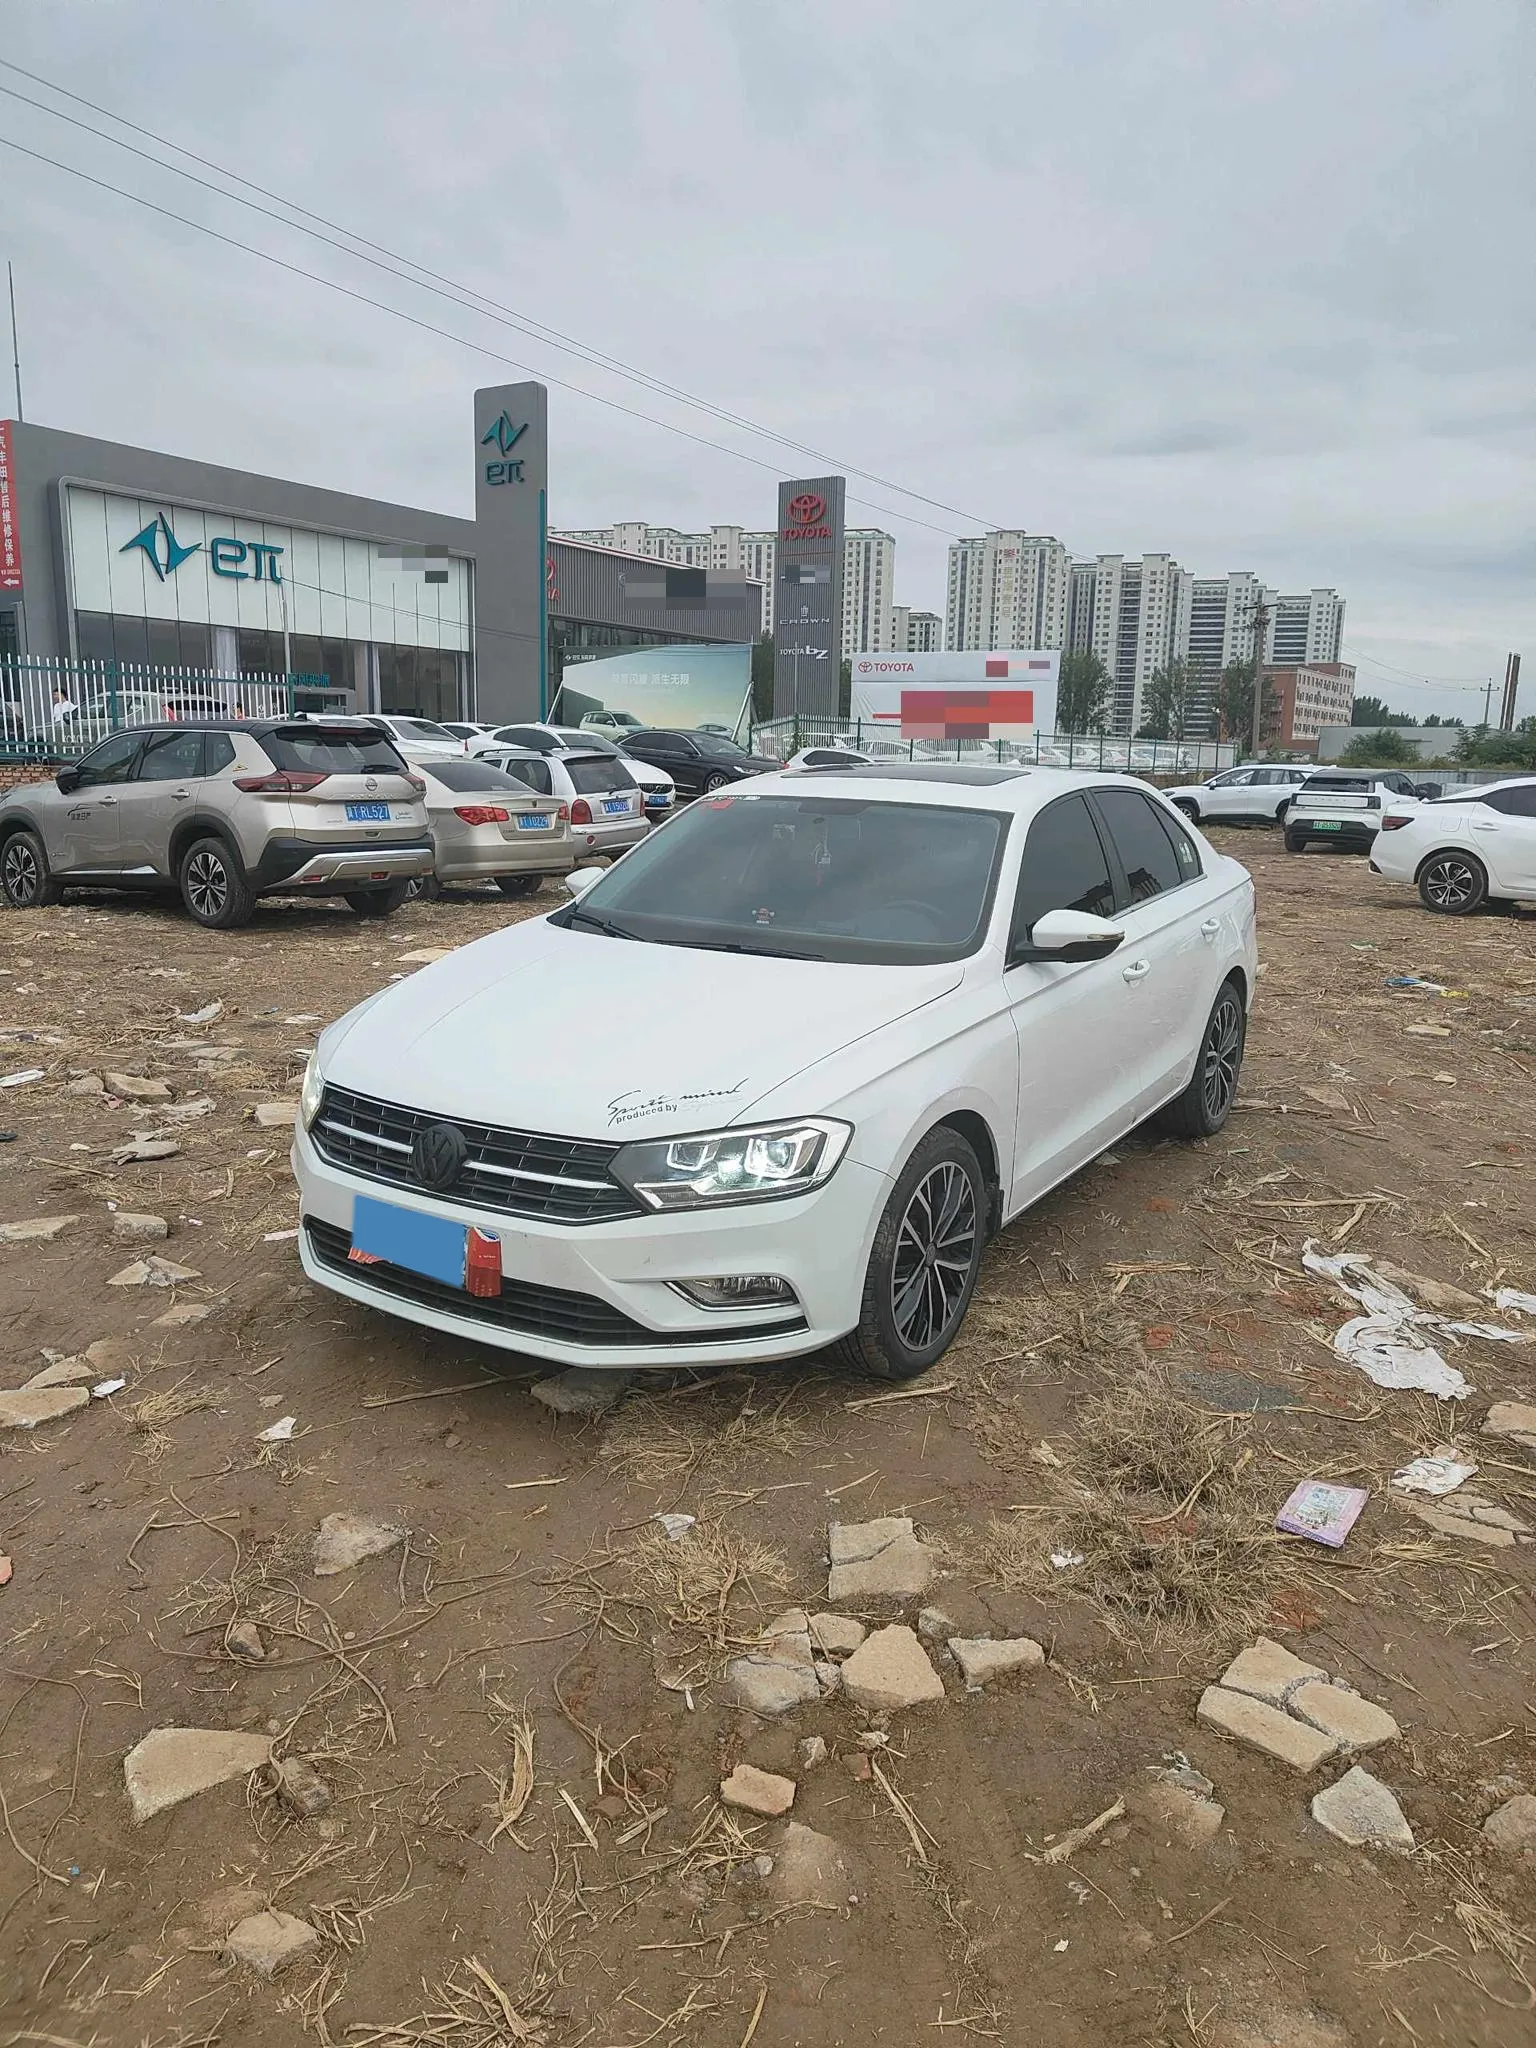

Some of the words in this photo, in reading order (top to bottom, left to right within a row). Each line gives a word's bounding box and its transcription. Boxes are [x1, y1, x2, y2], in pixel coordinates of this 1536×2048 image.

[782, 526, 832, 540] TOYOTA
[874, 662, 915, 672] TOYOTA
[616, 1106, 664, 1124] produced
[665, 1103, 678, 1113] by
